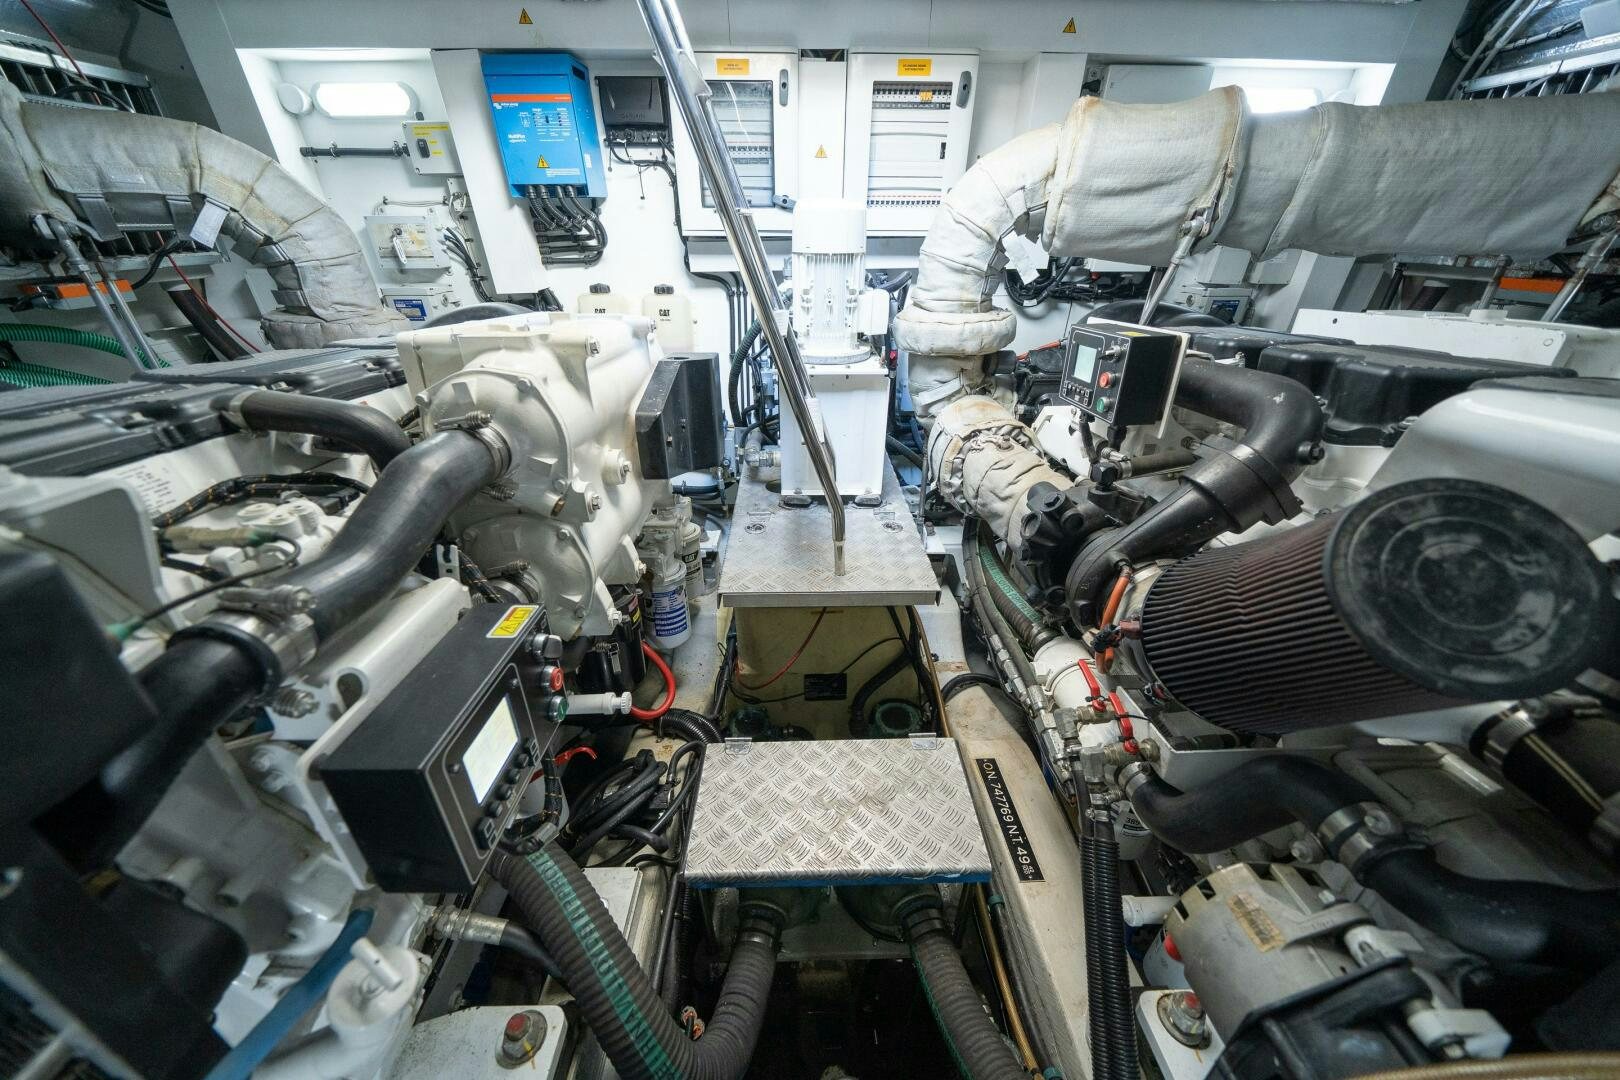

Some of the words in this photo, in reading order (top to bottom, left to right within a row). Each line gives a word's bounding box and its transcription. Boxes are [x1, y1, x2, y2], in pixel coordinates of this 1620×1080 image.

[658, 308, 671, 317] CAT
[990, 782, 1014, 822] 747769
[1016, 846, 1031, 864] 49
